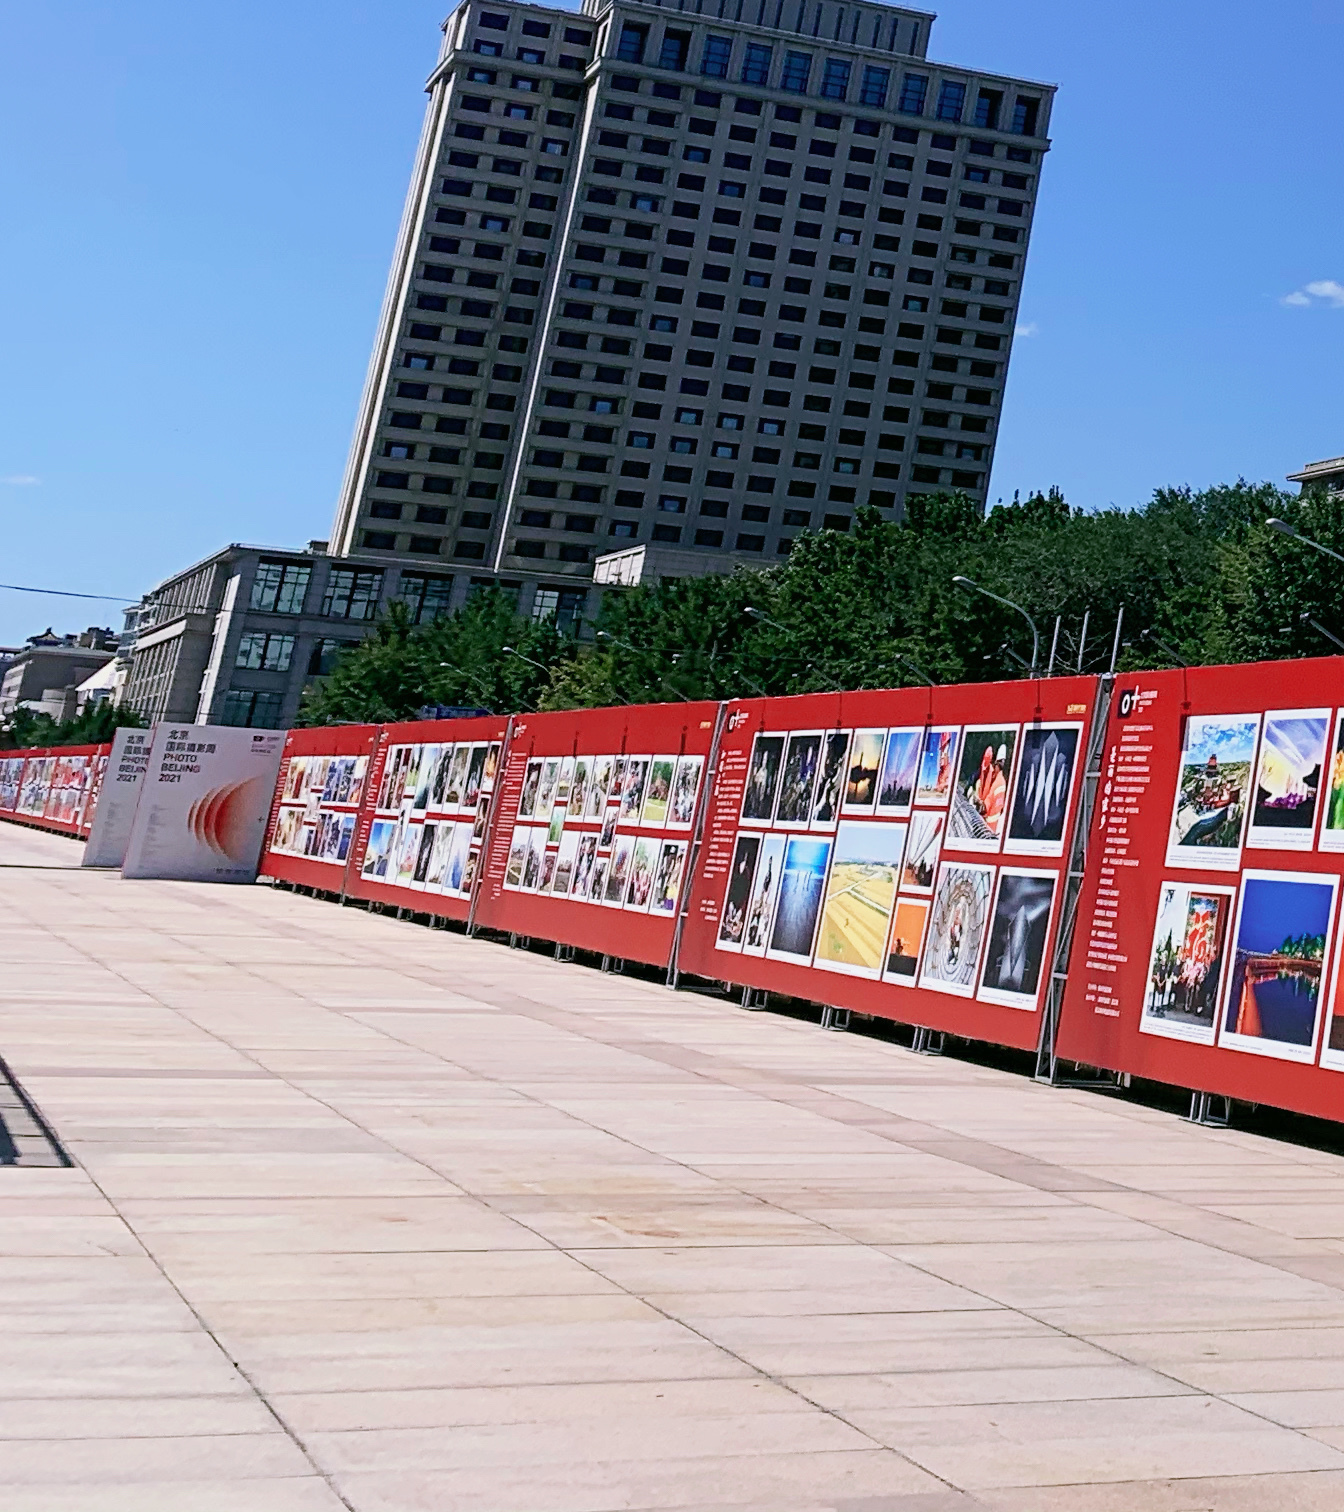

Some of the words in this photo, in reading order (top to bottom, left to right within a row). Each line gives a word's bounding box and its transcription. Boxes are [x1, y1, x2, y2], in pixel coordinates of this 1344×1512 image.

[167, 730, 190, 740] 北京
[163, 753, 198, 763] PHOTO
[118, 764, 147, 773] BEIJIN
[160, 762, 201, 773] BEIJING
[116, 774, 138, 782] 2021
[158, 773, 181, 783] 2021
